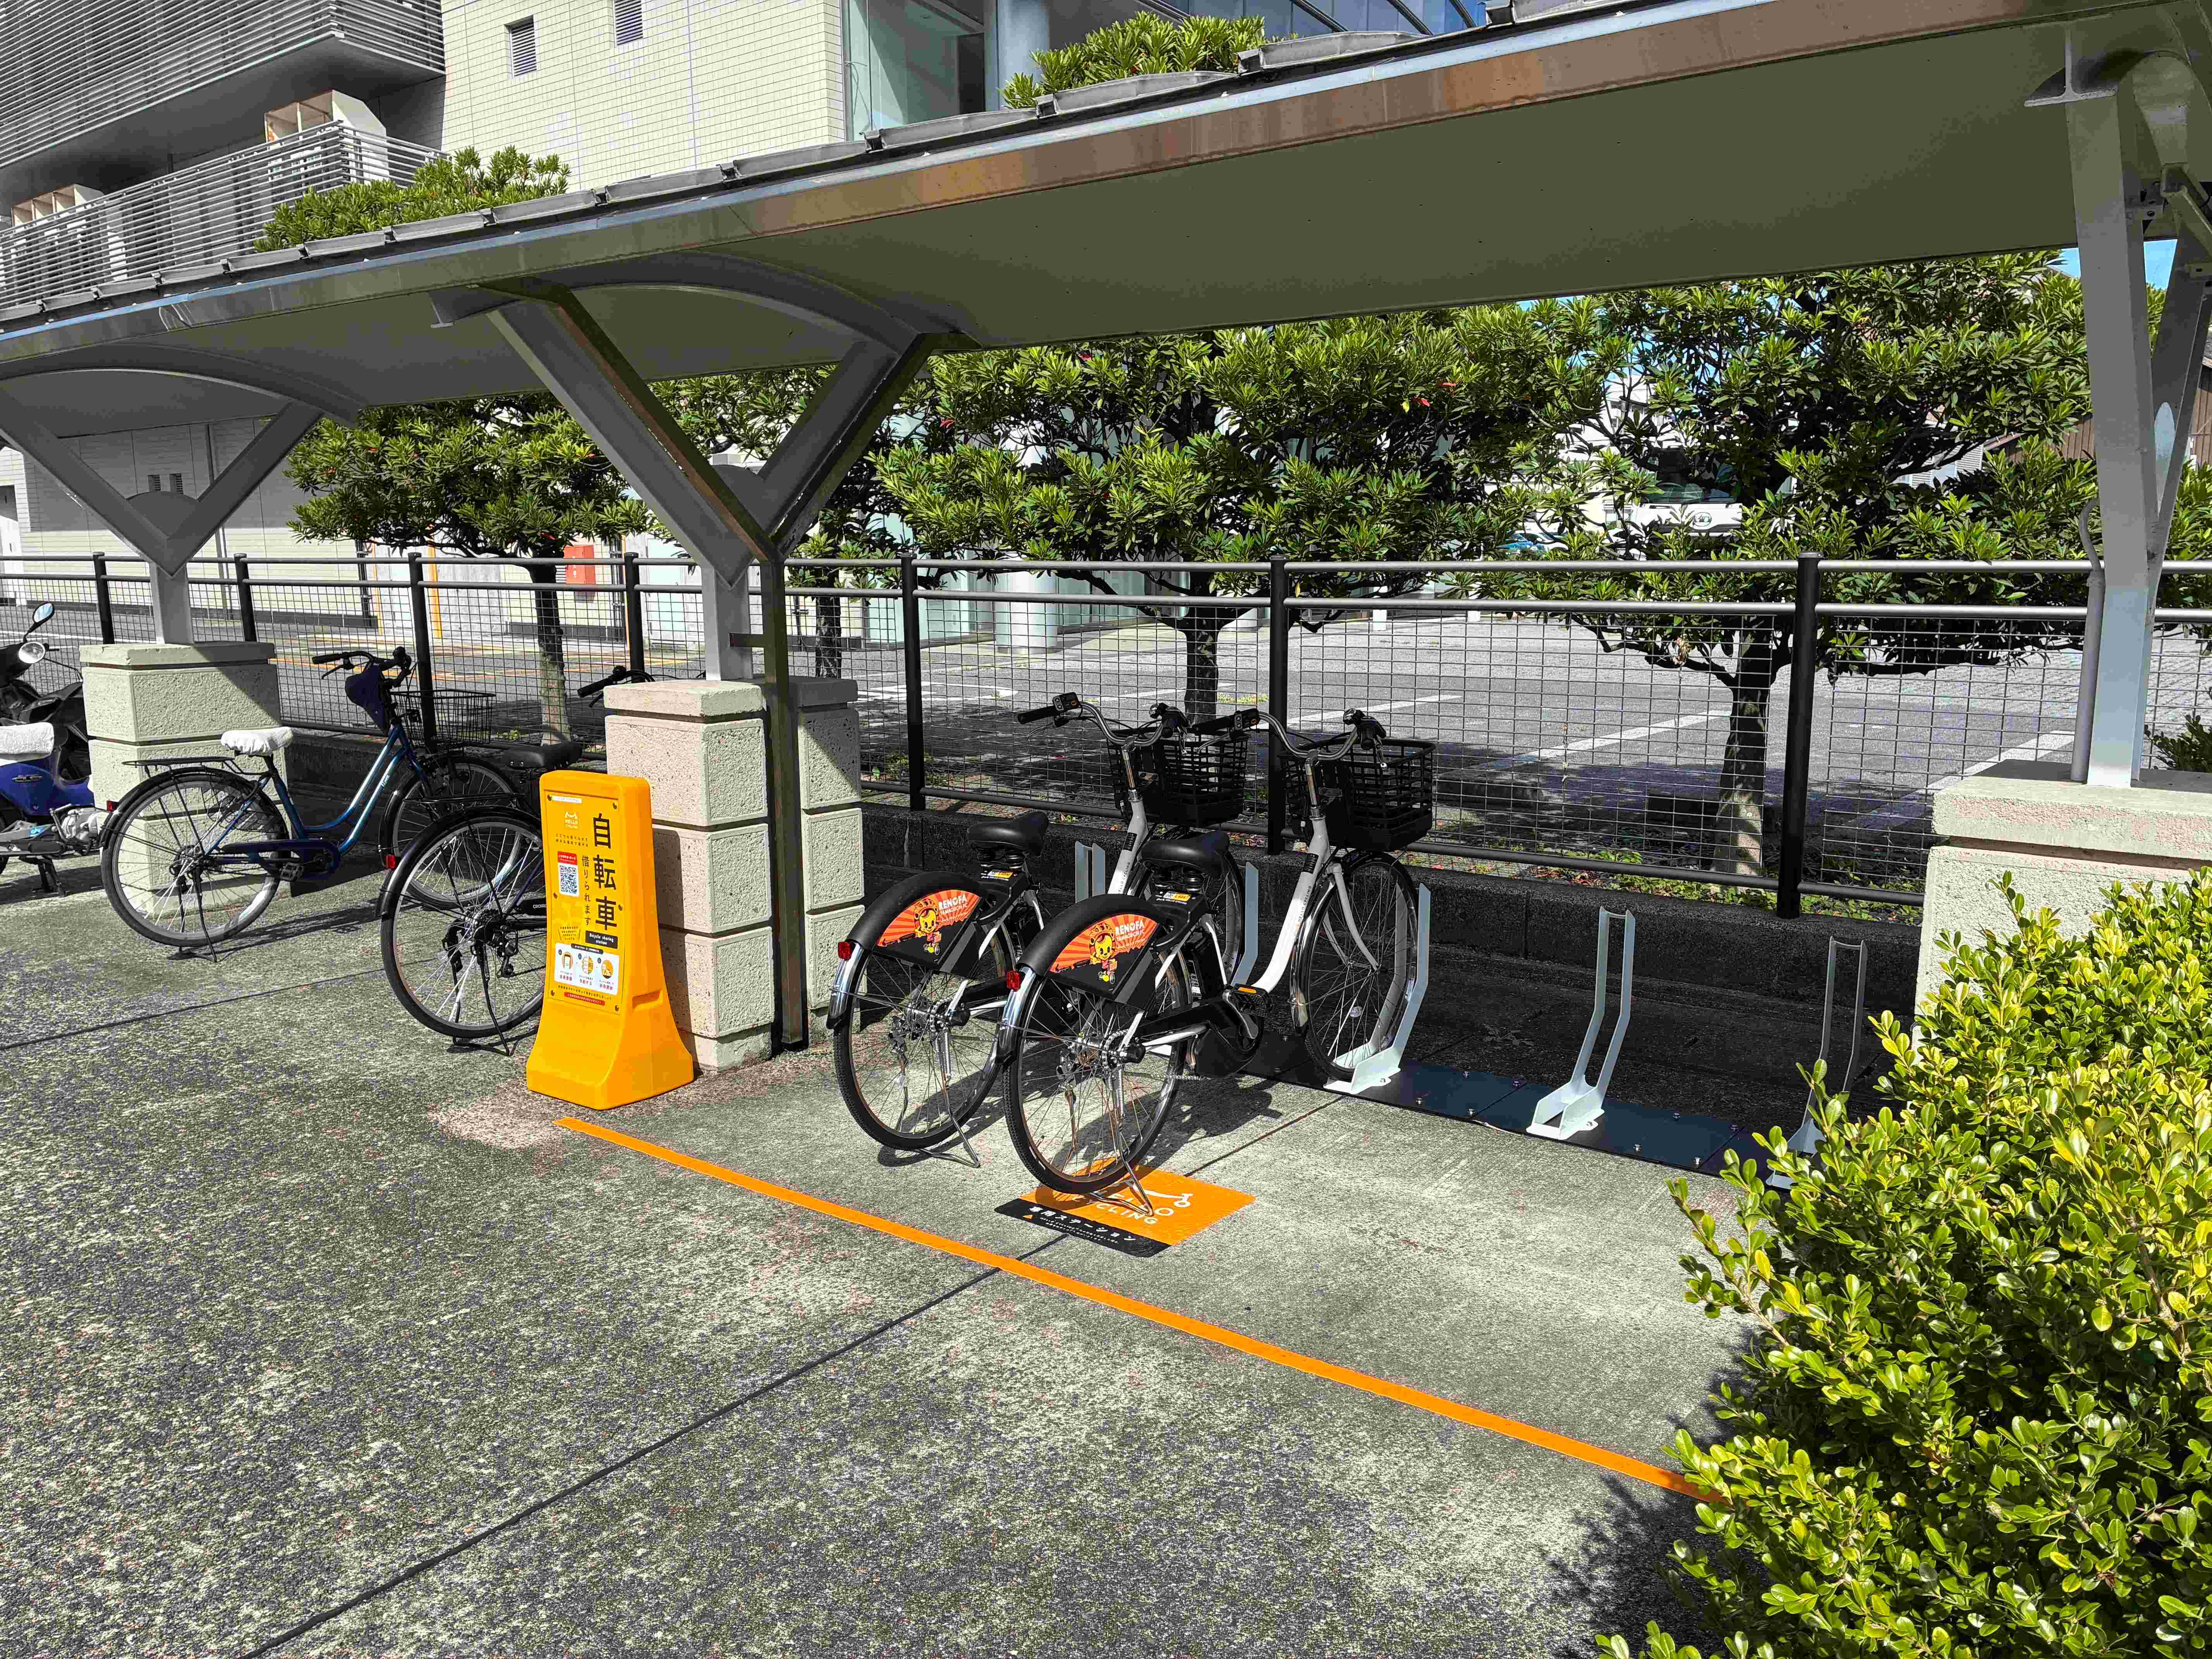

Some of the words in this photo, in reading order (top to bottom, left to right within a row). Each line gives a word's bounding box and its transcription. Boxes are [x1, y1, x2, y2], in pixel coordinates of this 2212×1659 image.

[582, 855, 591, 926] 借りられます
[592, 812, 617, 931] 自転車
[938, 894, 967, 910] RENOFA
[1115, 920, 1144, 936] RENOFA
